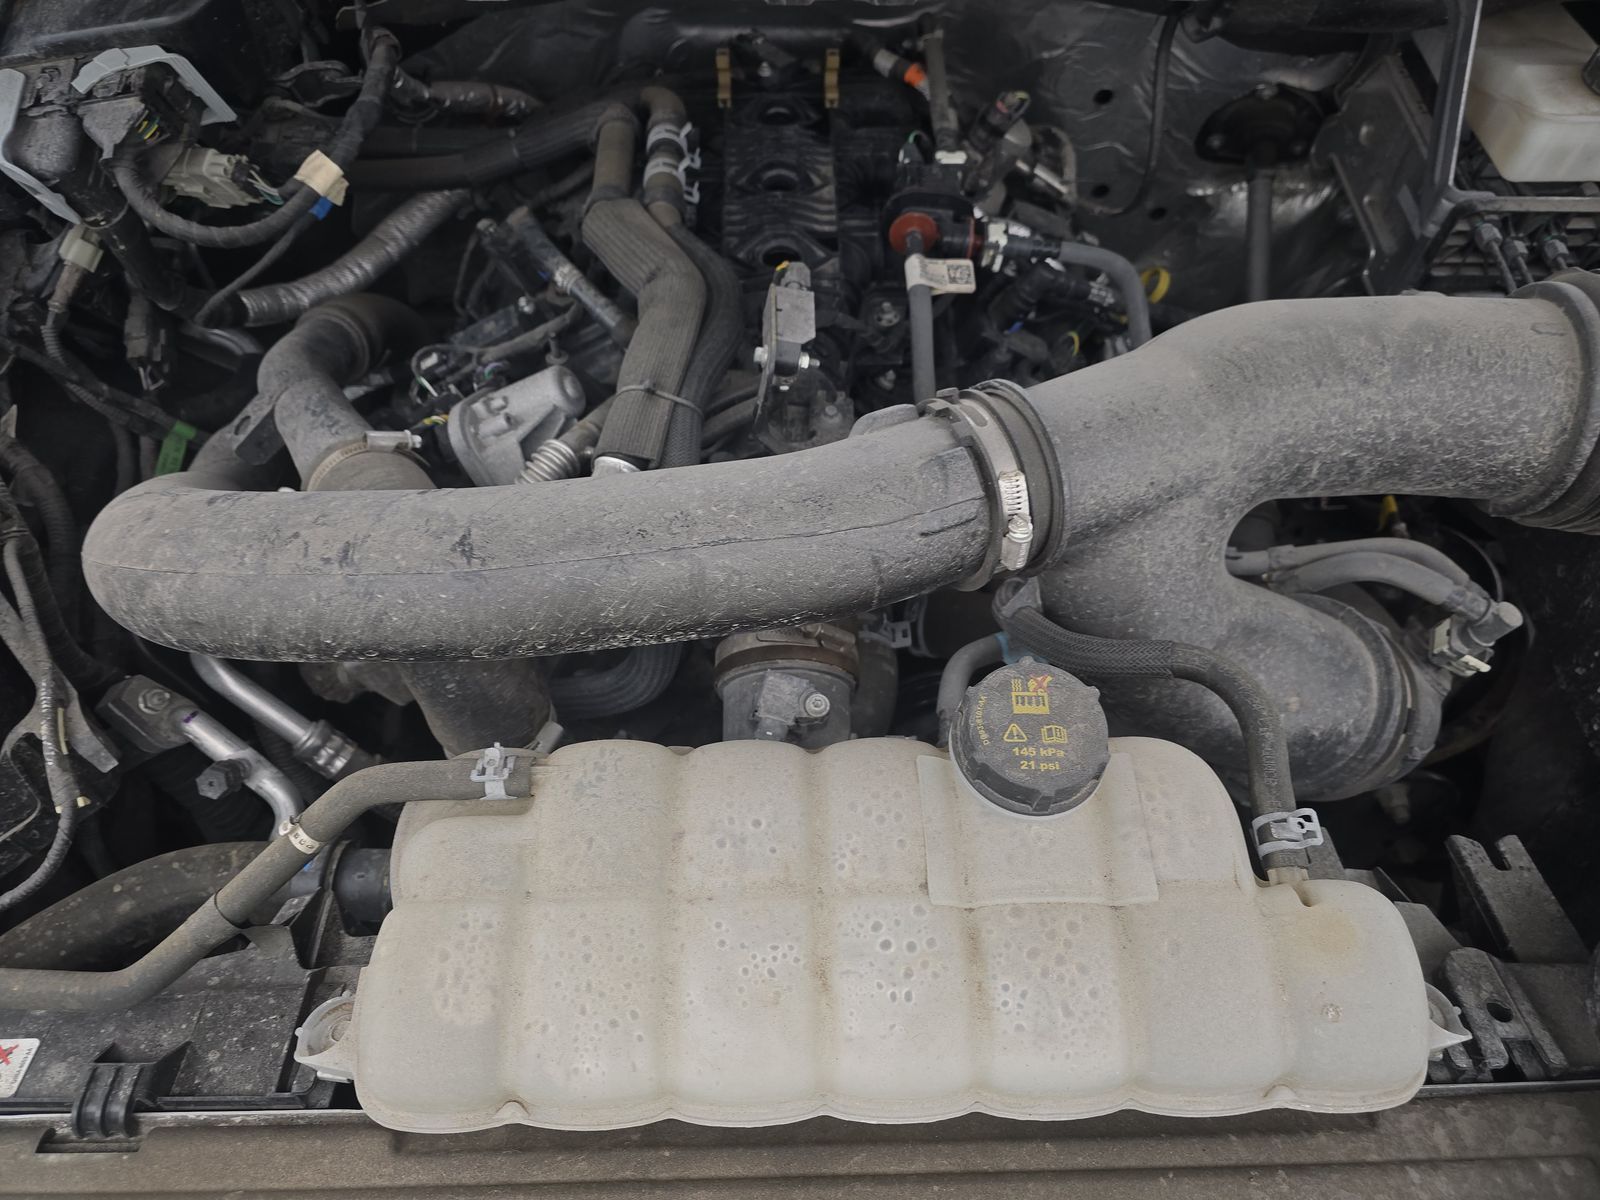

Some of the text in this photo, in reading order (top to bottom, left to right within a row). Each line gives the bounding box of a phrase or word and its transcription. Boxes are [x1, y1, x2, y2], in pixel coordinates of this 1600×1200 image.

[1013, 747, 1065, 757] 145 kPa
[1020, 761, 1060, 771] 21 psi
